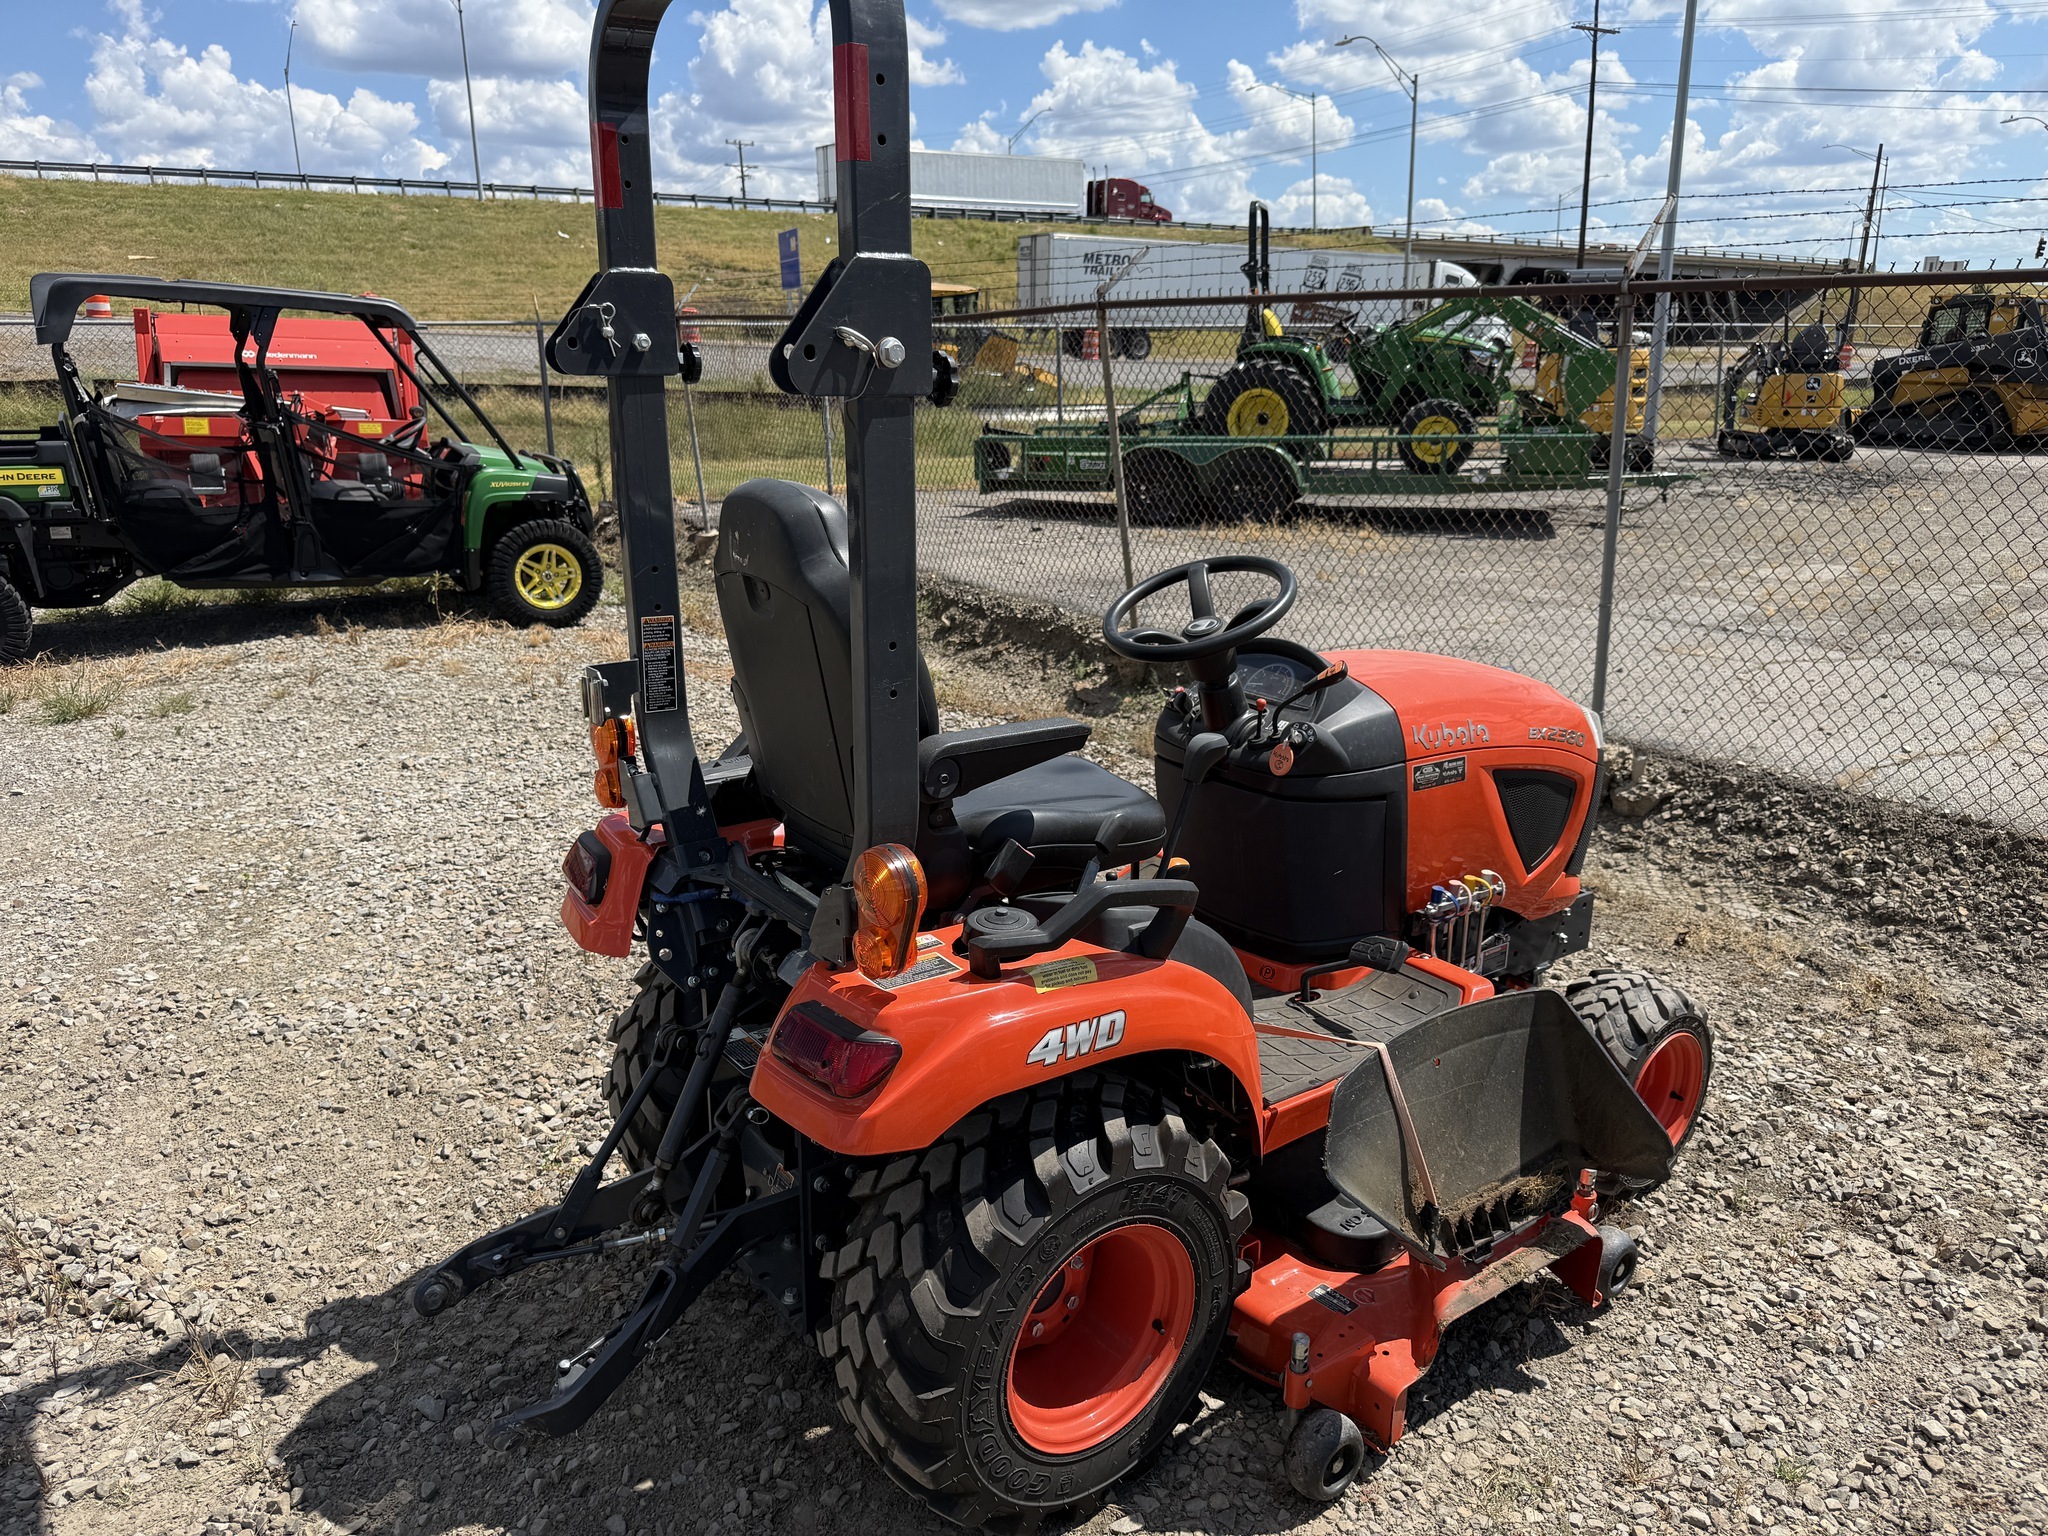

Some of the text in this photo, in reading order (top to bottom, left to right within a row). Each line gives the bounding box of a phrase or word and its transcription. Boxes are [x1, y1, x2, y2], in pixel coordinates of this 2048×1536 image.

[1083, 253, 1131, 265] METRO
[1084, 265, 1130, 276] TRAIL
[1899, 354, 1931, 365] DEERE
[16, 472, 56, 481] DEERE
[1411, 719, 1490, 750] Kubota
[1528, 726, 1586, 747] BX2380
[1026, 1009, 1126, 1067] 4WD
[969, 1264, 1052, 1495] GOODYEAR
